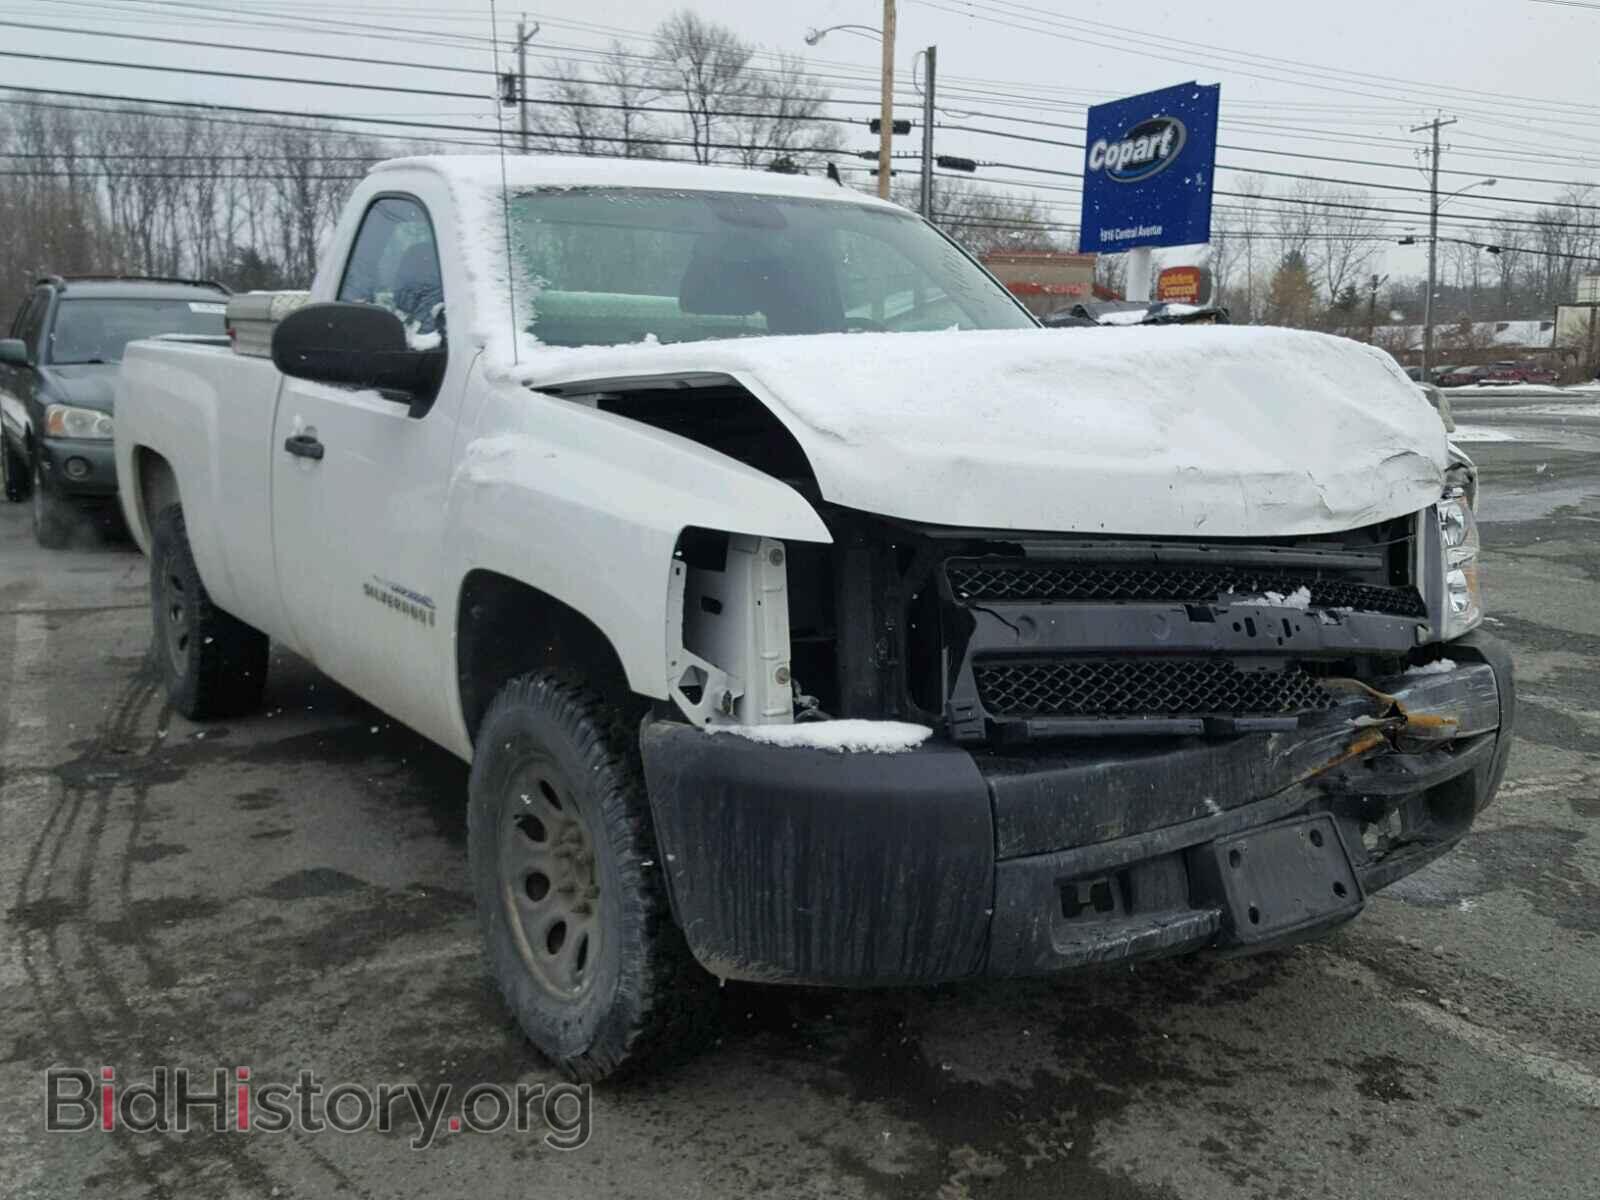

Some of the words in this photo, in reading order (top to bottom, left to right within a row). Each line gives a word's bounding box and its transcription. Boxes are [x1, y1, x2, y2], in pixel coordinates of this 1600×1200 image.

[1089, 123, 1173, 174] Copart
[1115, 226, 1137, 240] Central
[1138, 224, 1162, 237] Avenue
